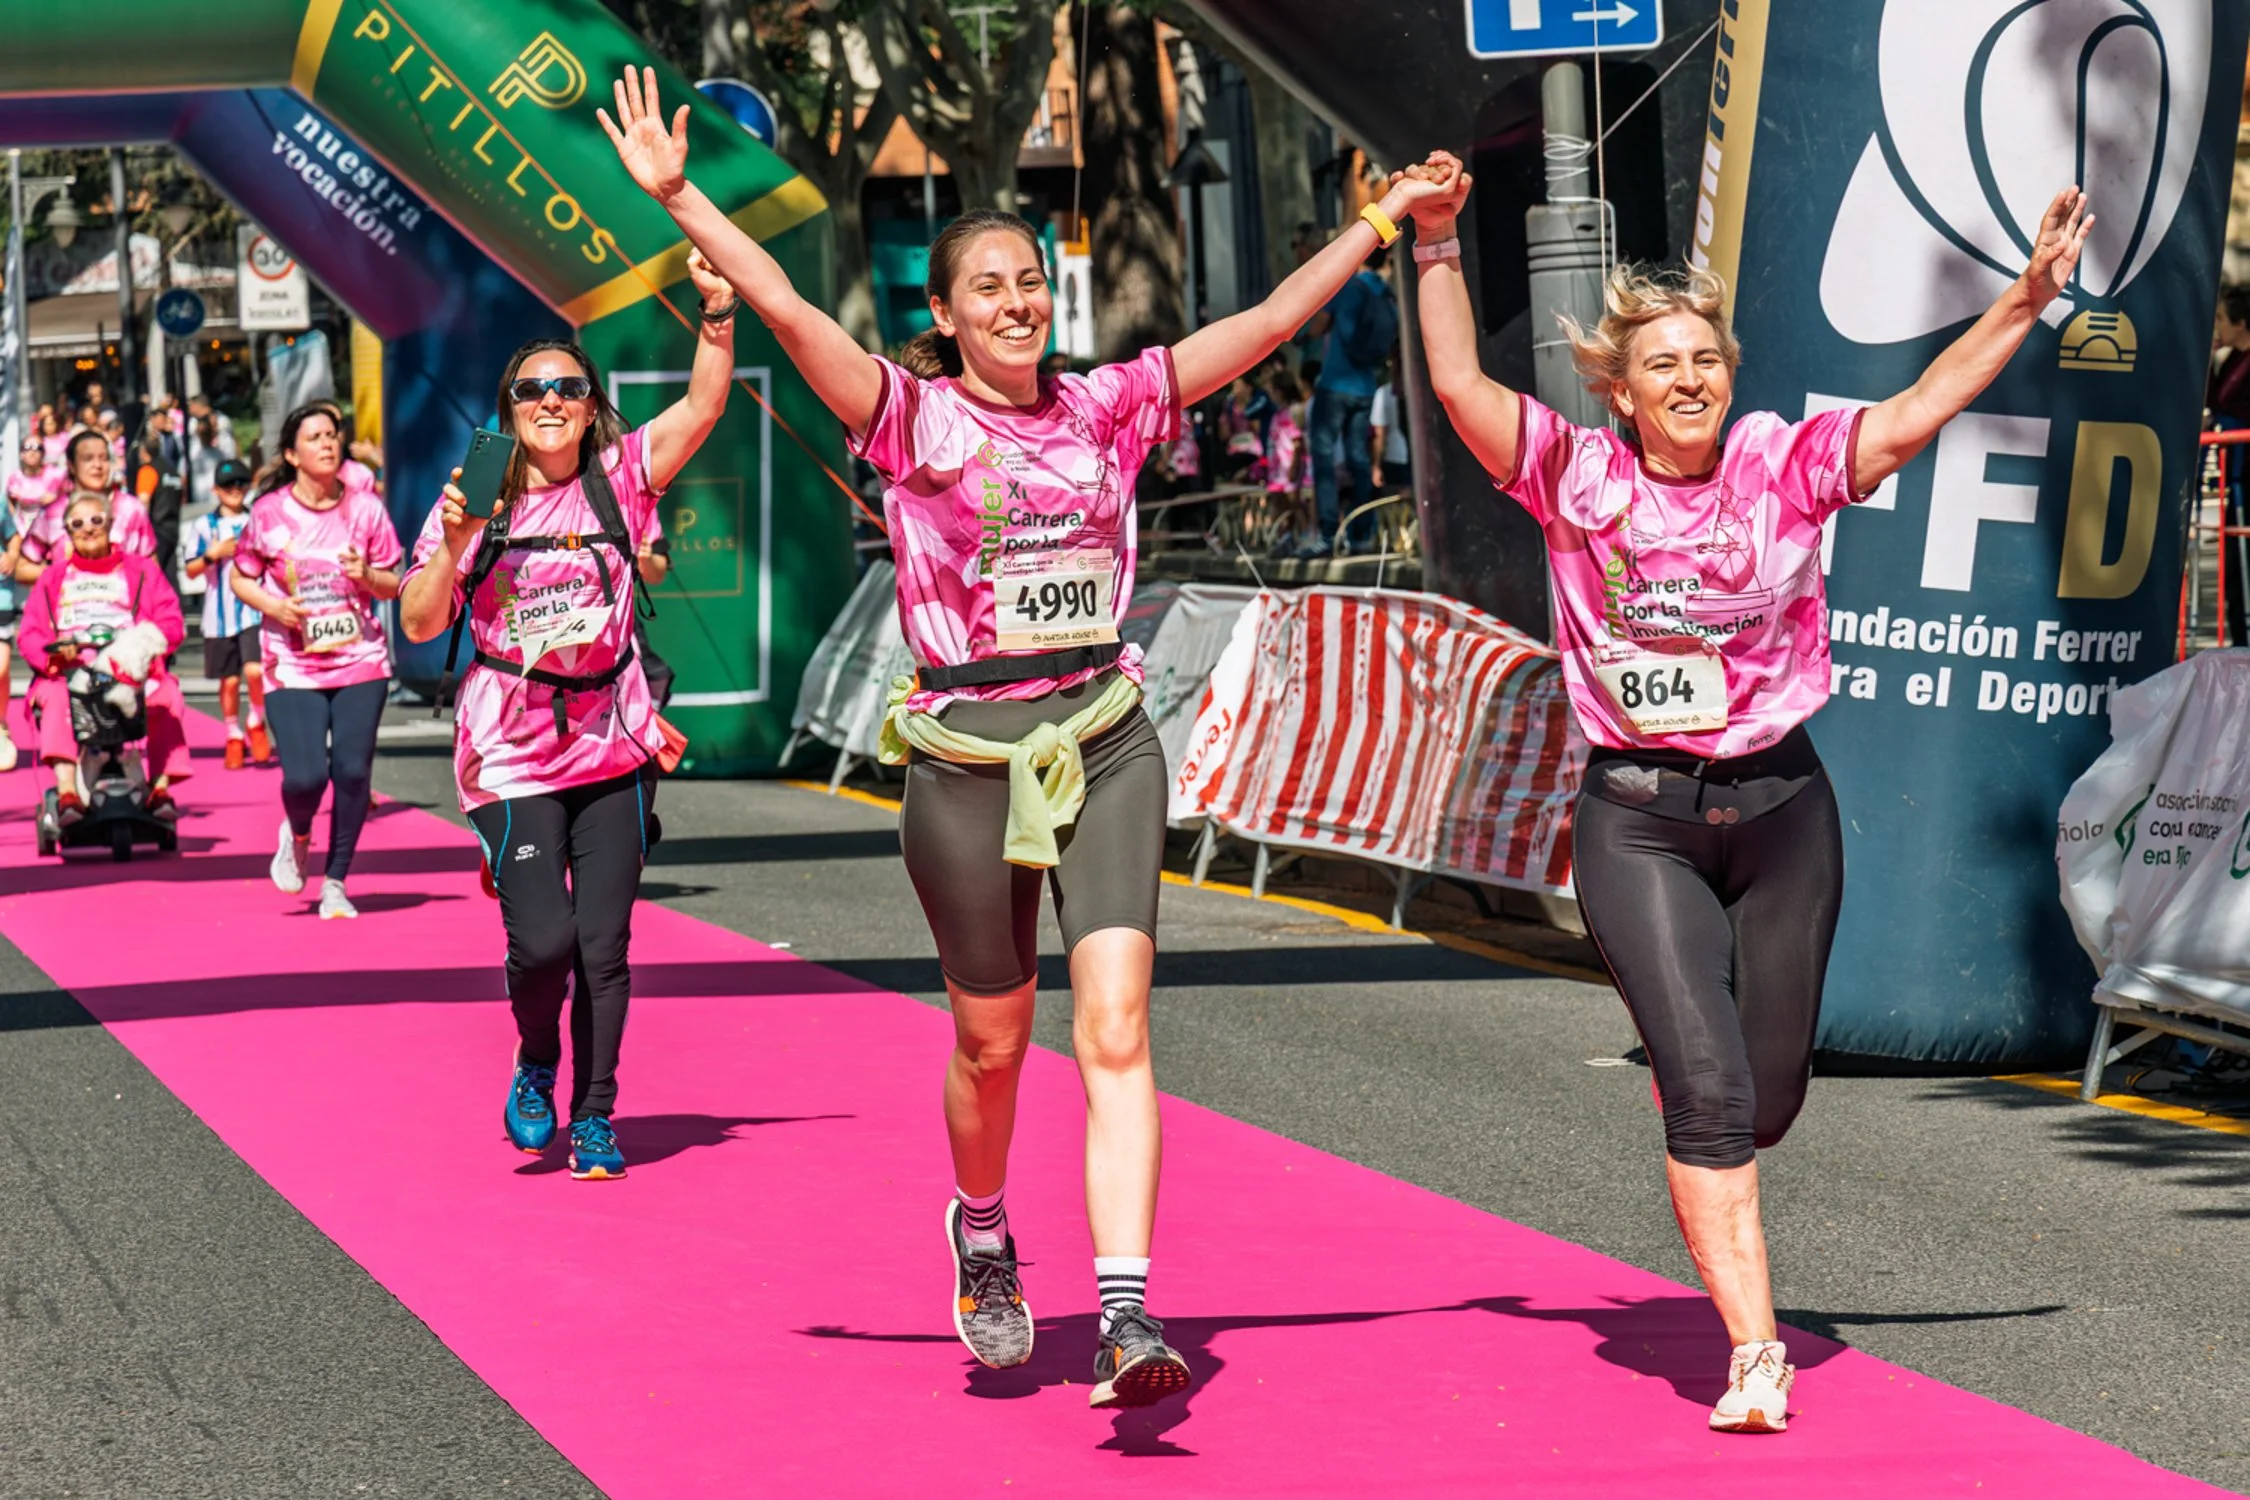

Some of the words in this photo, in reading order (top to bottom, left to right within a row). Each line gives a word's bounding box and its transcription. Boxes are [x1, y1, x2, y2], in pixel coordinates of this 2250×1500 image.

[354, 9, 616, 264] PITILLOS
[293, 110, 422, 232] nuestra
[271, 131, 397, 256] vocación.
[1008, 506, 1083, 529] Carrera
[1003, 536, 1041, 555] por
[515, 575, 586, 602] Carrera
[1016, 579, 1097, 622] 4990
[1626, 577, 1701, 595] Carrera
[312, 617, 354, 639] 6443
[519, 602, 550, 625] por
[551, 598, 571, 615] la
[1623, 603, 1657, 623] por
[1660, 601, 1683, 618] la
[1827, 606, 2019, 659] ndación
[2033, 620, 2143, 663] Ferrer
[1620, 667, 1694, 708] 864
[1829, 662, 1878, 700] ra
[1905, 667, 1952, 708] el
[1977, 670, 2130, 724] Deport
